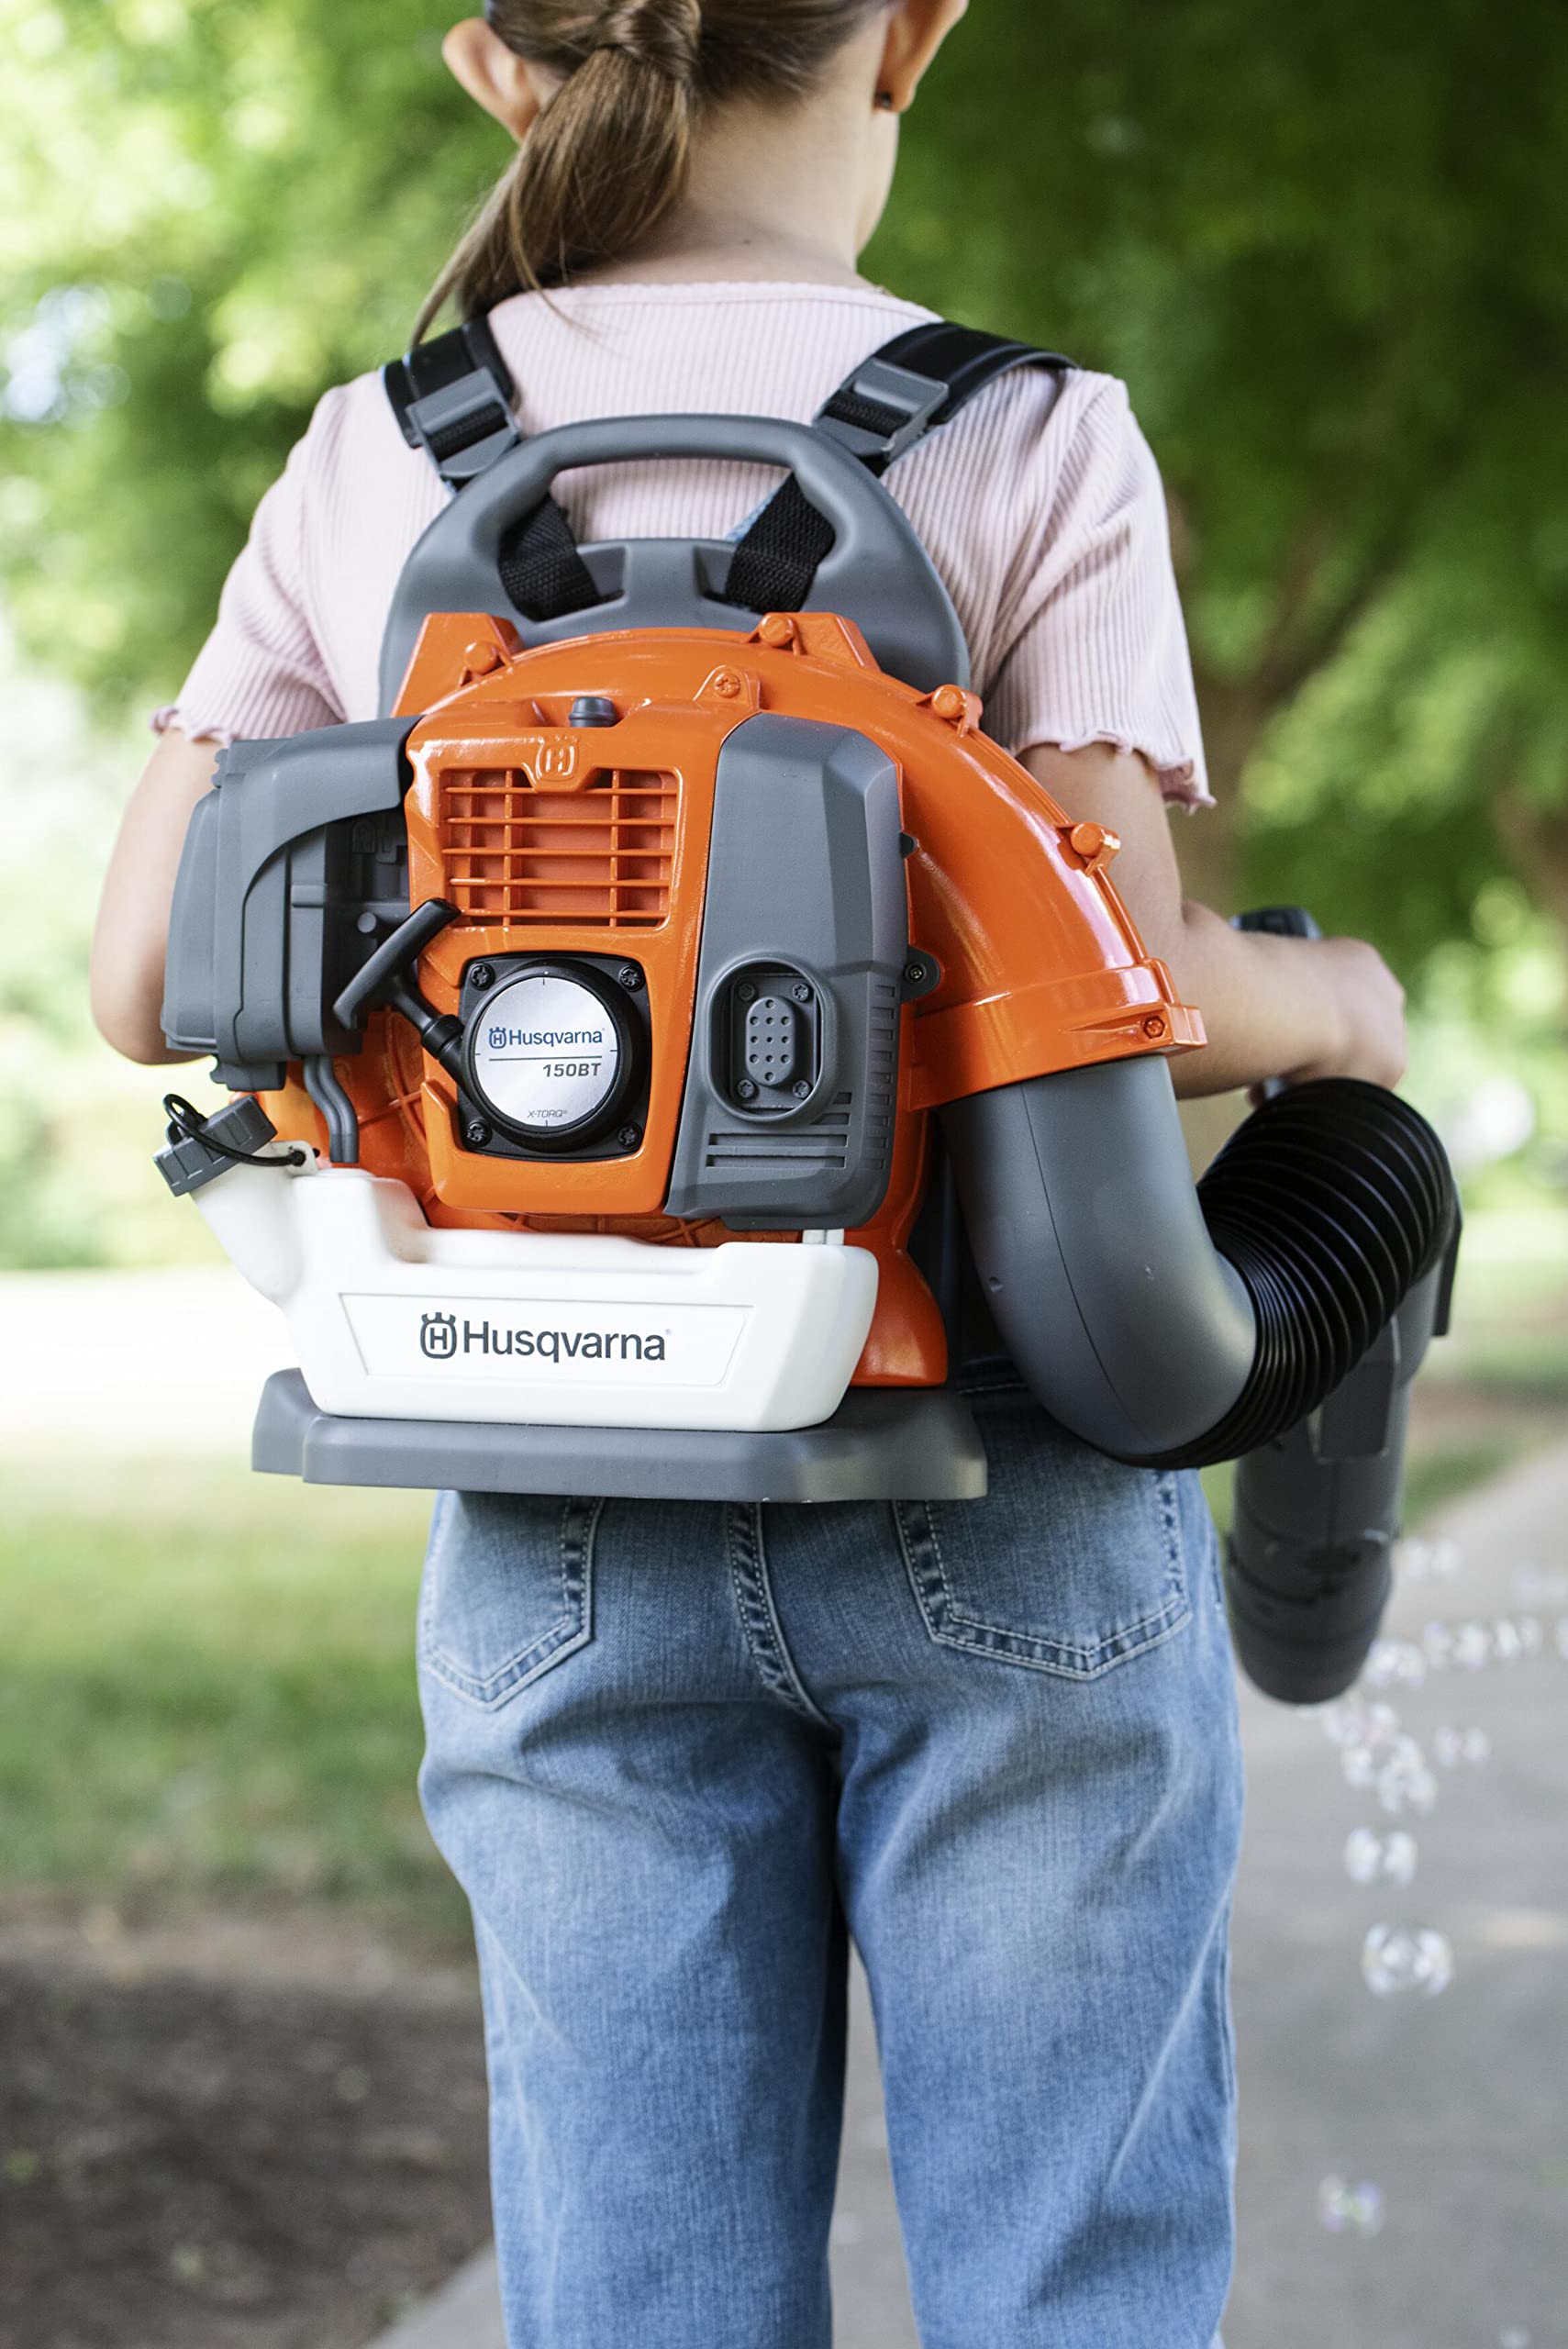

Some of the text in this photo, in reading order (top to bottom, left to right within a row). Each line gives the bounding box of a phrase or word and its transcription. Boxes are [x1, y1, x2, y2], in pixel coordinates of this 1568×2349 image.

[509, 1029, 603, 1047] Husqvarna
[542, 1063, 601, 1077] 150BT
[463, 1320, 665, 1363] Husqvarna
